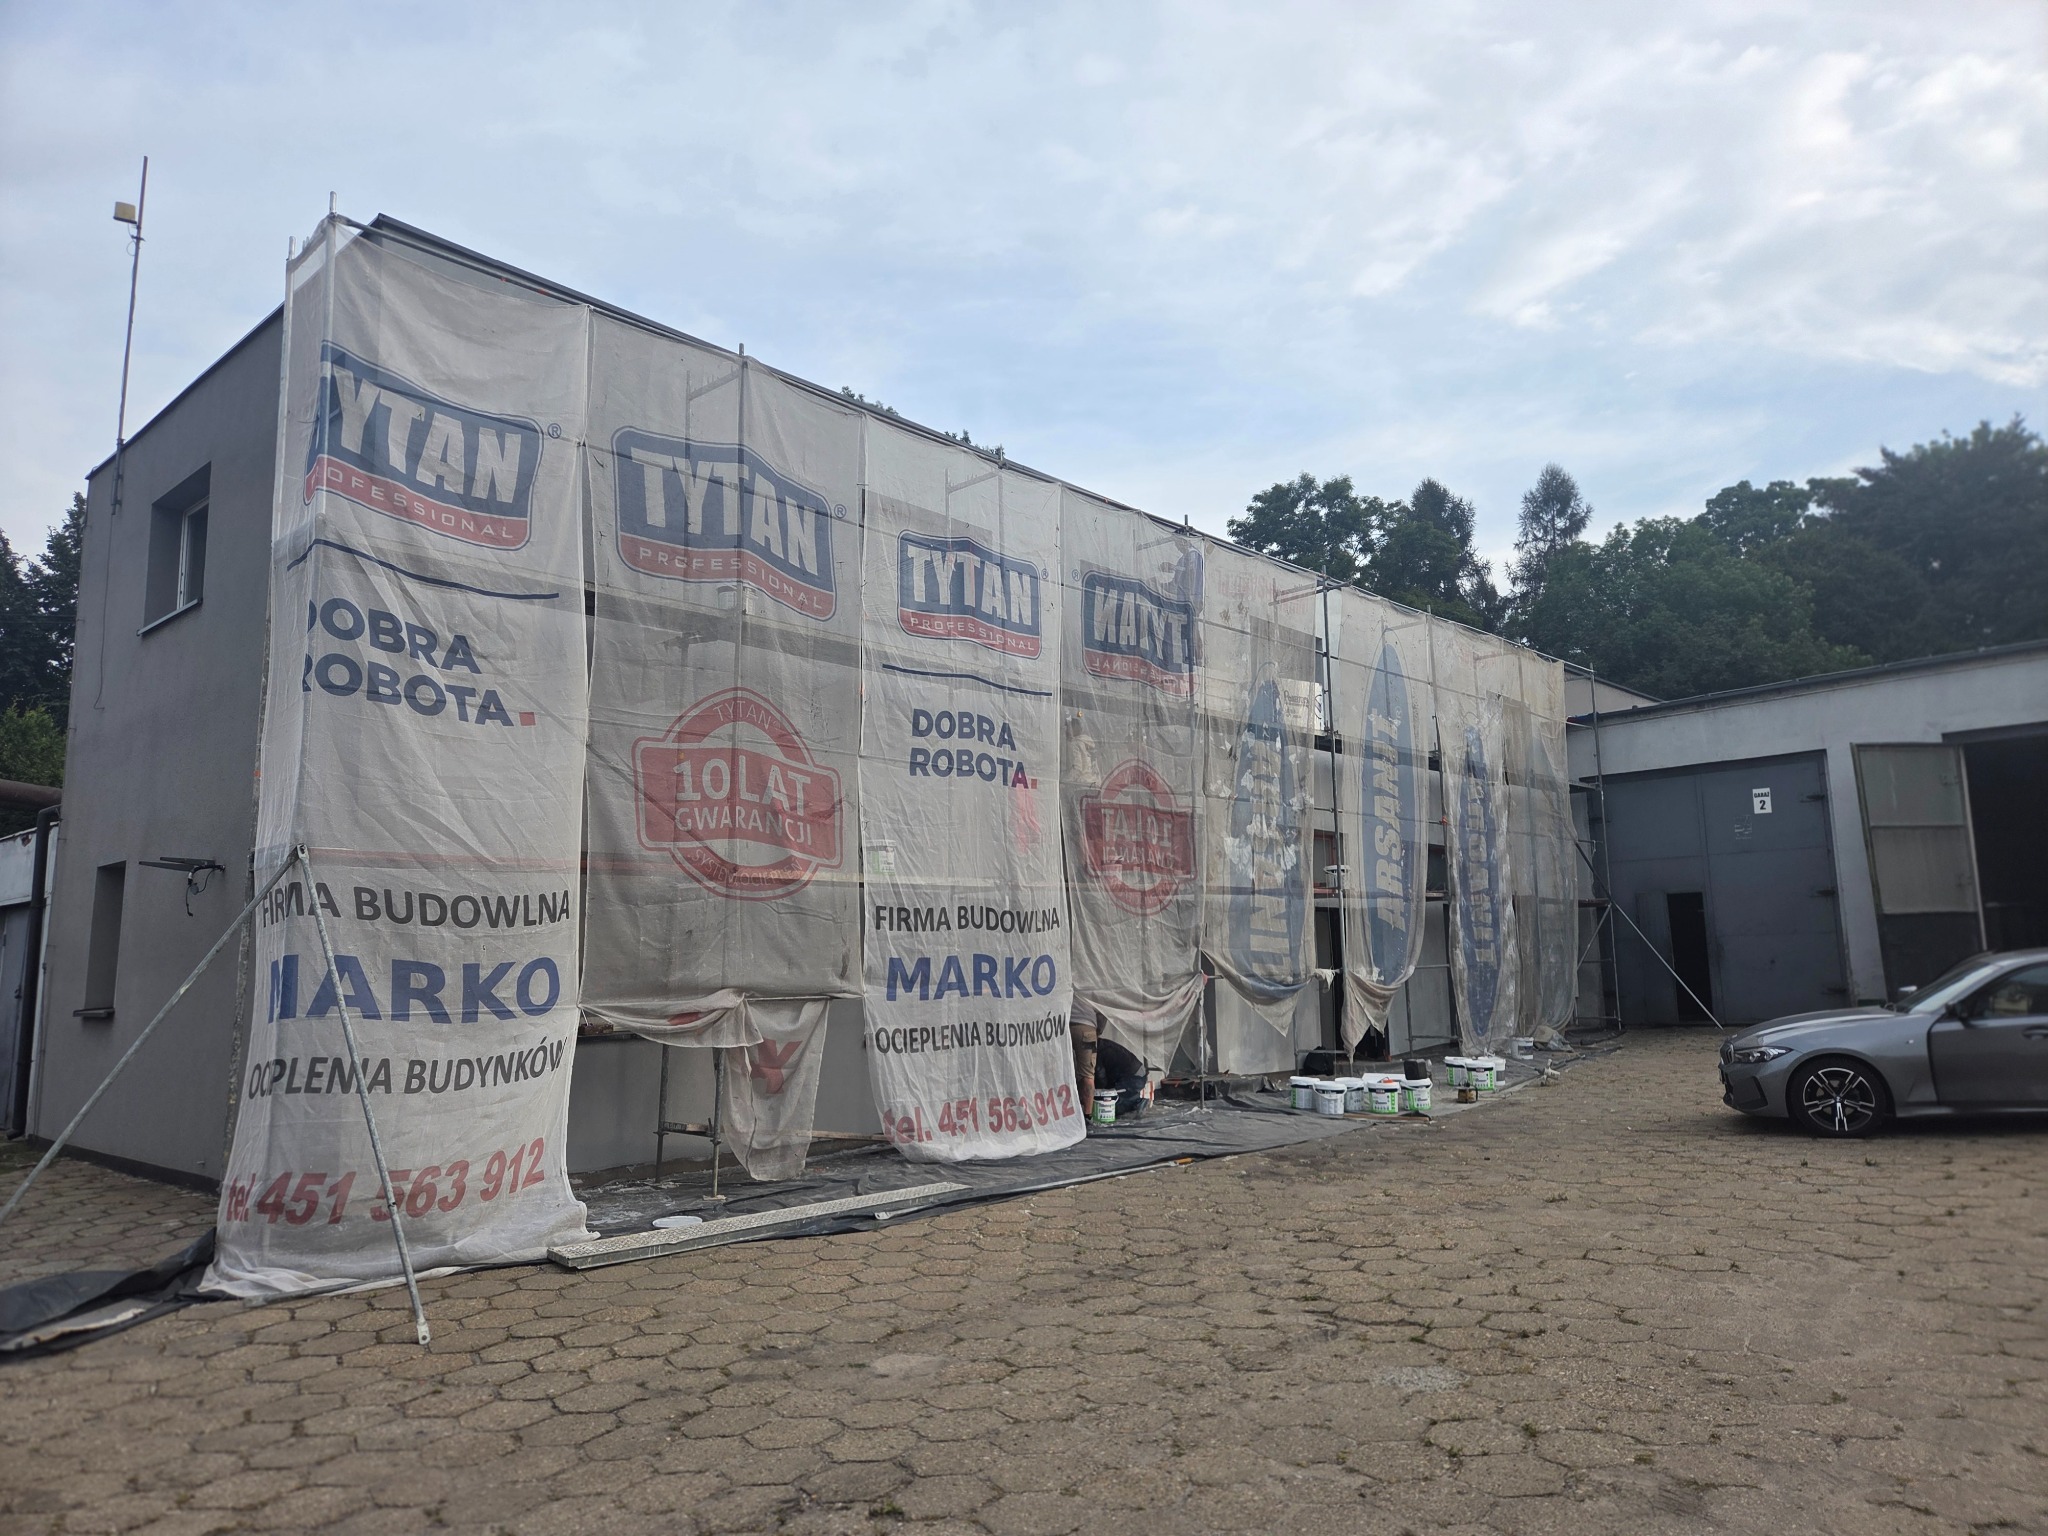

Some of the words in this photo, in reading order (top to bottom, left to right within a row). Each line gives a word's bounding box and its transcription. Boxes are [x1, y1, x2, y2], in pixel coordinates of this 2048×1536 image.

[630, 447, 819, 576] TYTAN
[639, 546, 823, 609] PROFESSIONAL
[907, 545, 1032, 626] TYTAN
[911, 617, 1035, 651] PROFESSIONAL
[713, 700, 772, 730] TYTAN
[911, 708, 1017, 751] DOBRA
[672, 758, 731, 801] 10
[738, 754, 812, 817] LAT
[909, 747, 1038, 790] ROBOTA.
[674, 805, 812, 846] GWARANCJI
[1372, 707, 1406, 934] ARSANIT
[1759, 799, 1767, 810] 2
[262, 881, 342, 929] FIRMA
[353, 886, 570, 928] BUDOWLNA
[875, 905, 951, 932] FIRMA
[957, 905, 1061, 934] BUDOWLNA
[268, 953, 560, 1024] MARKO
[886, 953, 1056, 1002] MARKO
[875, 1021, 981, 1054] OCIEPLENIA
[986, 1010, 1066, 1048] BUDYNKÓW
[403, 1036, 568, 1095] BUDYNKÓW
[883, 1106, 933, 1144] tel.
[938, 1097, 980, 1138] 451
[988, 1095, 1033, 1134] 563
[1034, 1083, 1076, 1127] 912
[256, 1171, 357, 1226] 451
[369, 1159, 470, 1222] 563
[479, 1136, 546, 1202] 912
